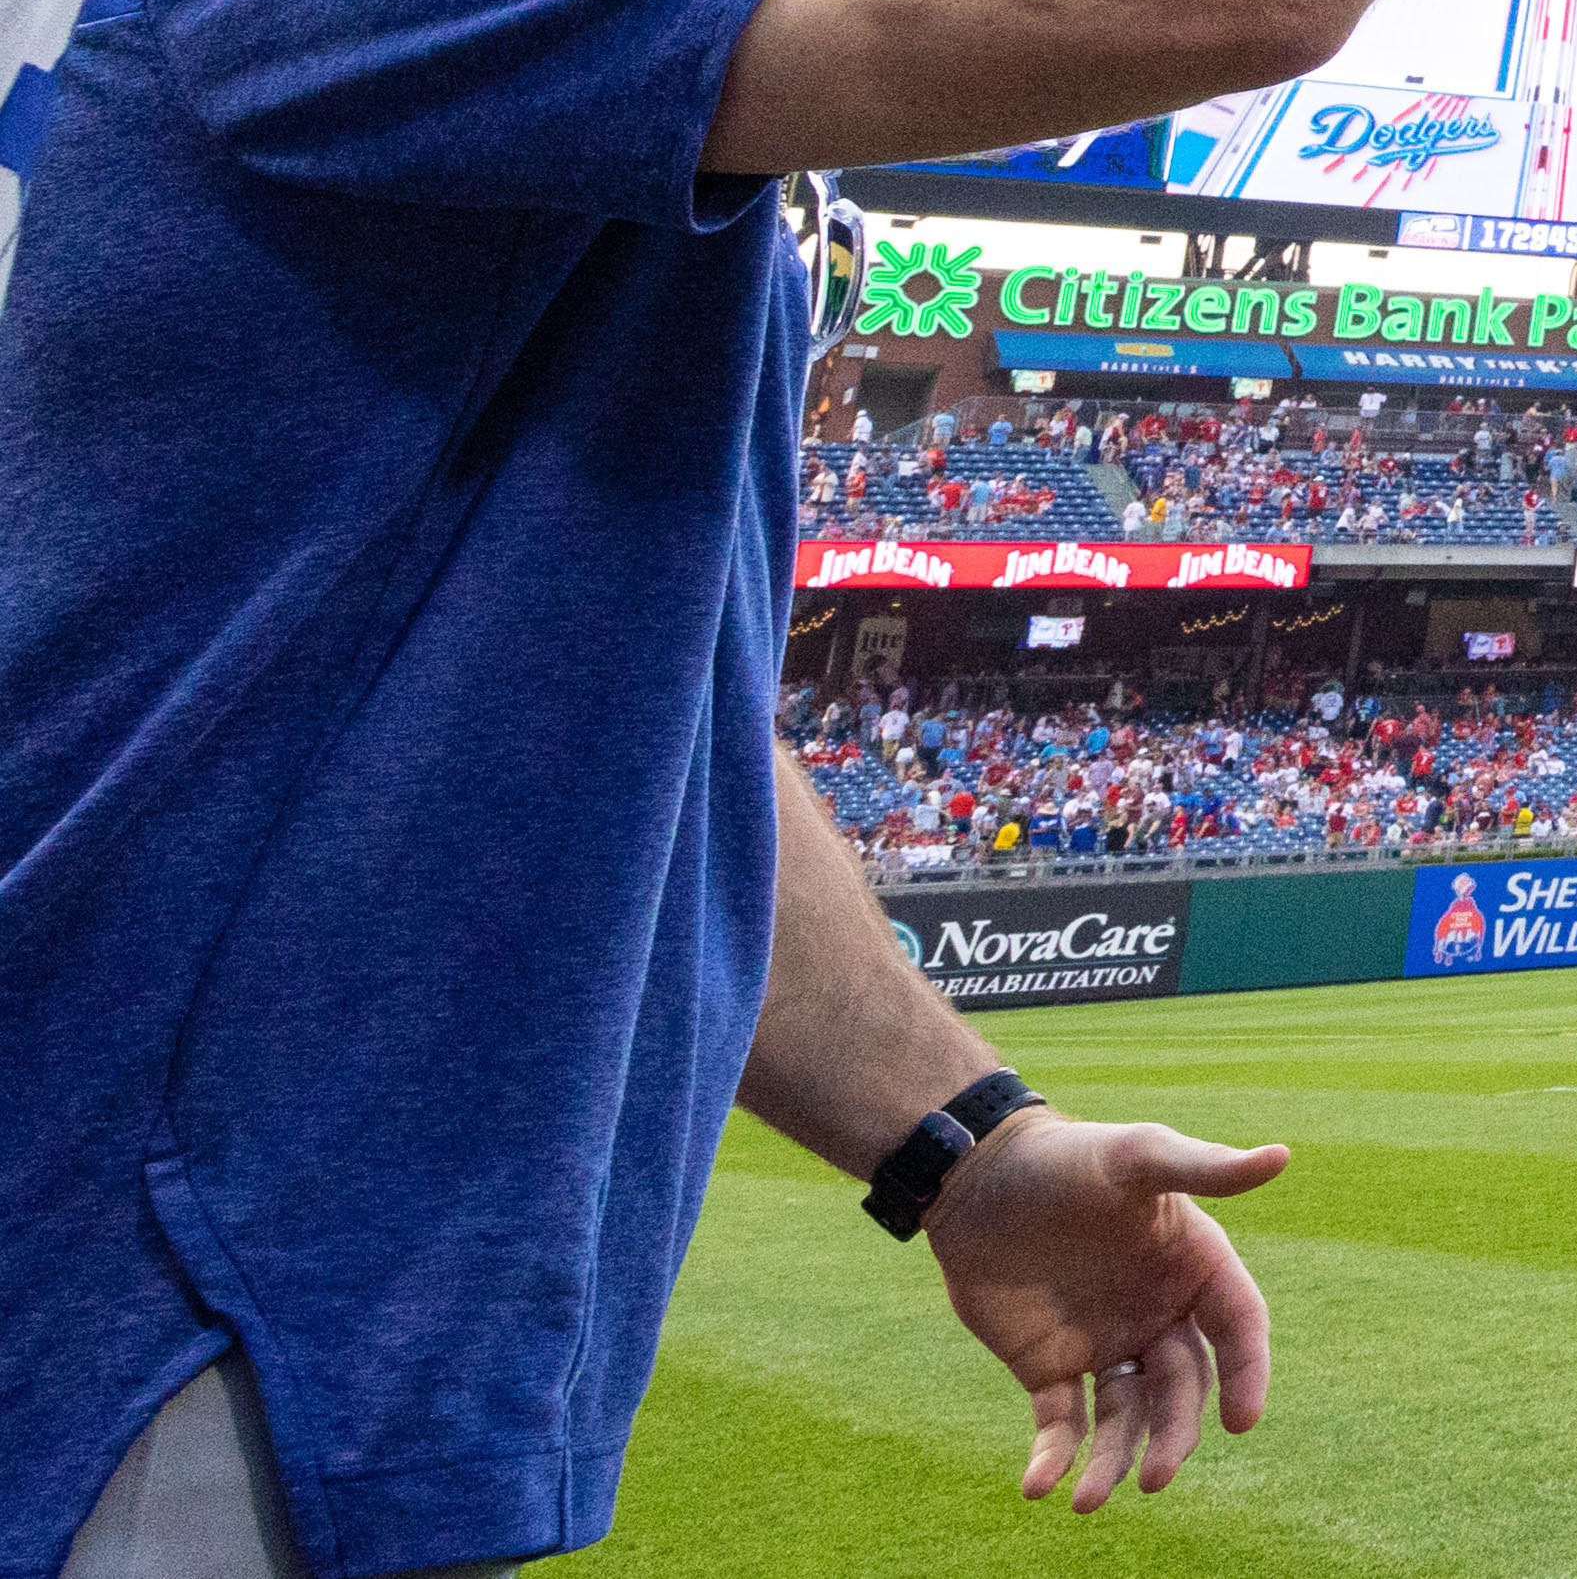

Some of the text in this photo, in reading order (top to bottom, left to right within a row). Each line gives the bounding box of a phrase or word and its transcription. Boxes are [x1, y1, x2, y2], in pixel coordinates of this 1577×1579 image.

[1297, 103, 1500, 173] Dodgers
[1000, 265, 1318, 337] Citizens
[1333, 283, 1518, 346] Bank
[1343, 350, 1476, 370] HARRY
[807, 541, 954, 588] JIM BEAM
[993, 542, 1131, 588] JIM BEAM
[1168, 544, 1298, 588] JIM BEAM
[924, 913, 1176, 968] NovaCare
